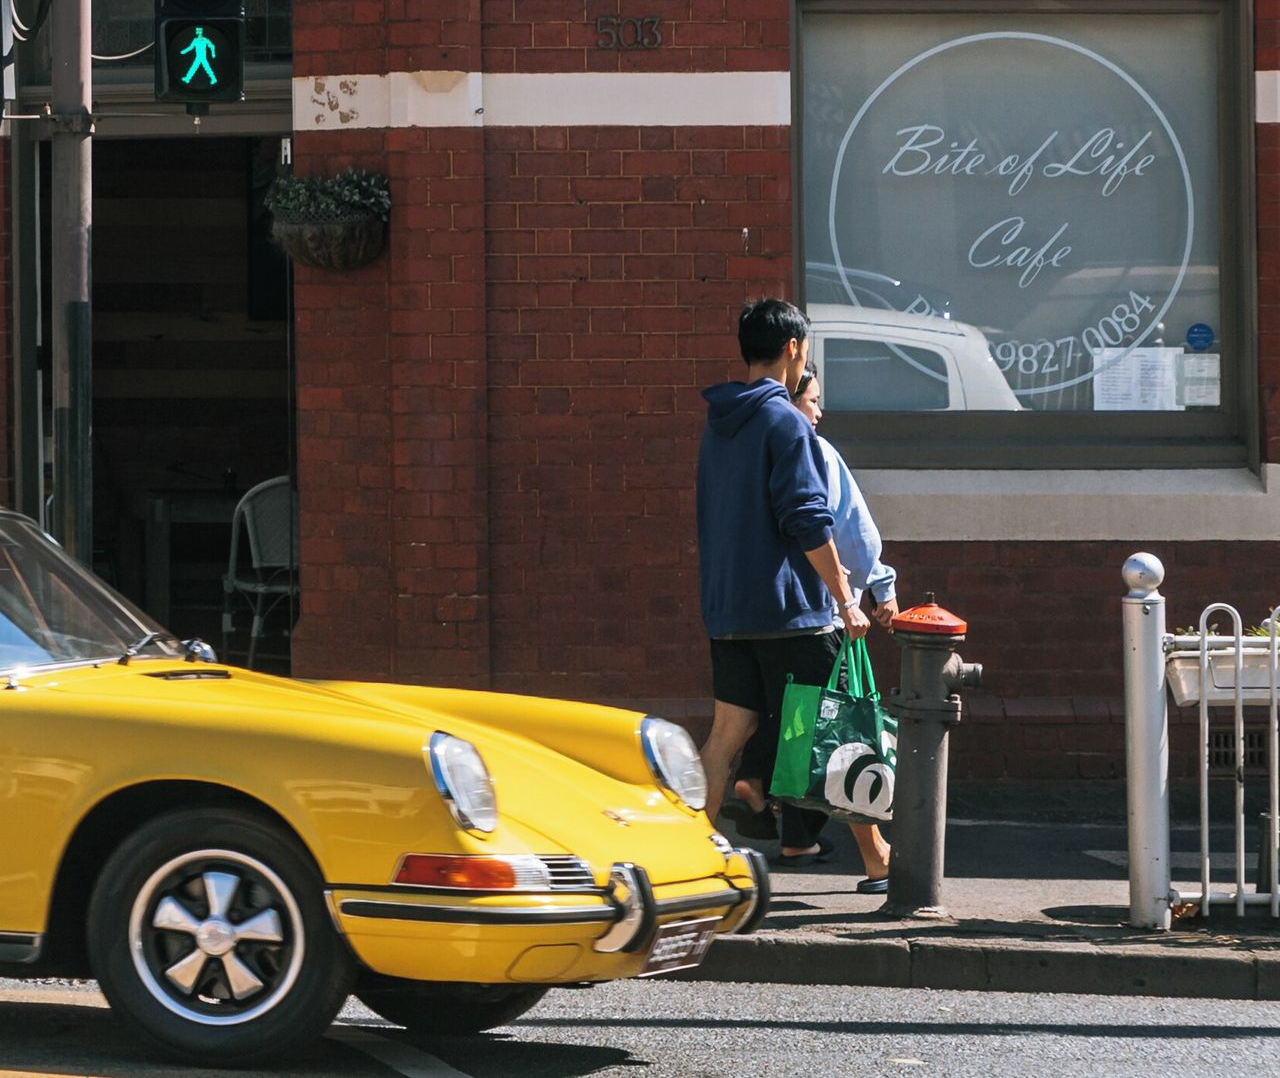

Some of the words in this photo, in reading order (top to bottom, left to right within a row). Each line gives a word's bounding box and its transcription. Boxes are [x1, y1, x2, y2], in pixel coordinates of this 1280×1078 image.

[596, 17, 662, 49] 503
[882, 123, 986, 177] Bite
[986, 130, 1058, 197] of
[1042, 126, 1156, 198] Life
[967, 216, 1073, 290] Cafe
[994, 335, 1076, 375] 9827
[1081, 289, 1157, 357] 0084
